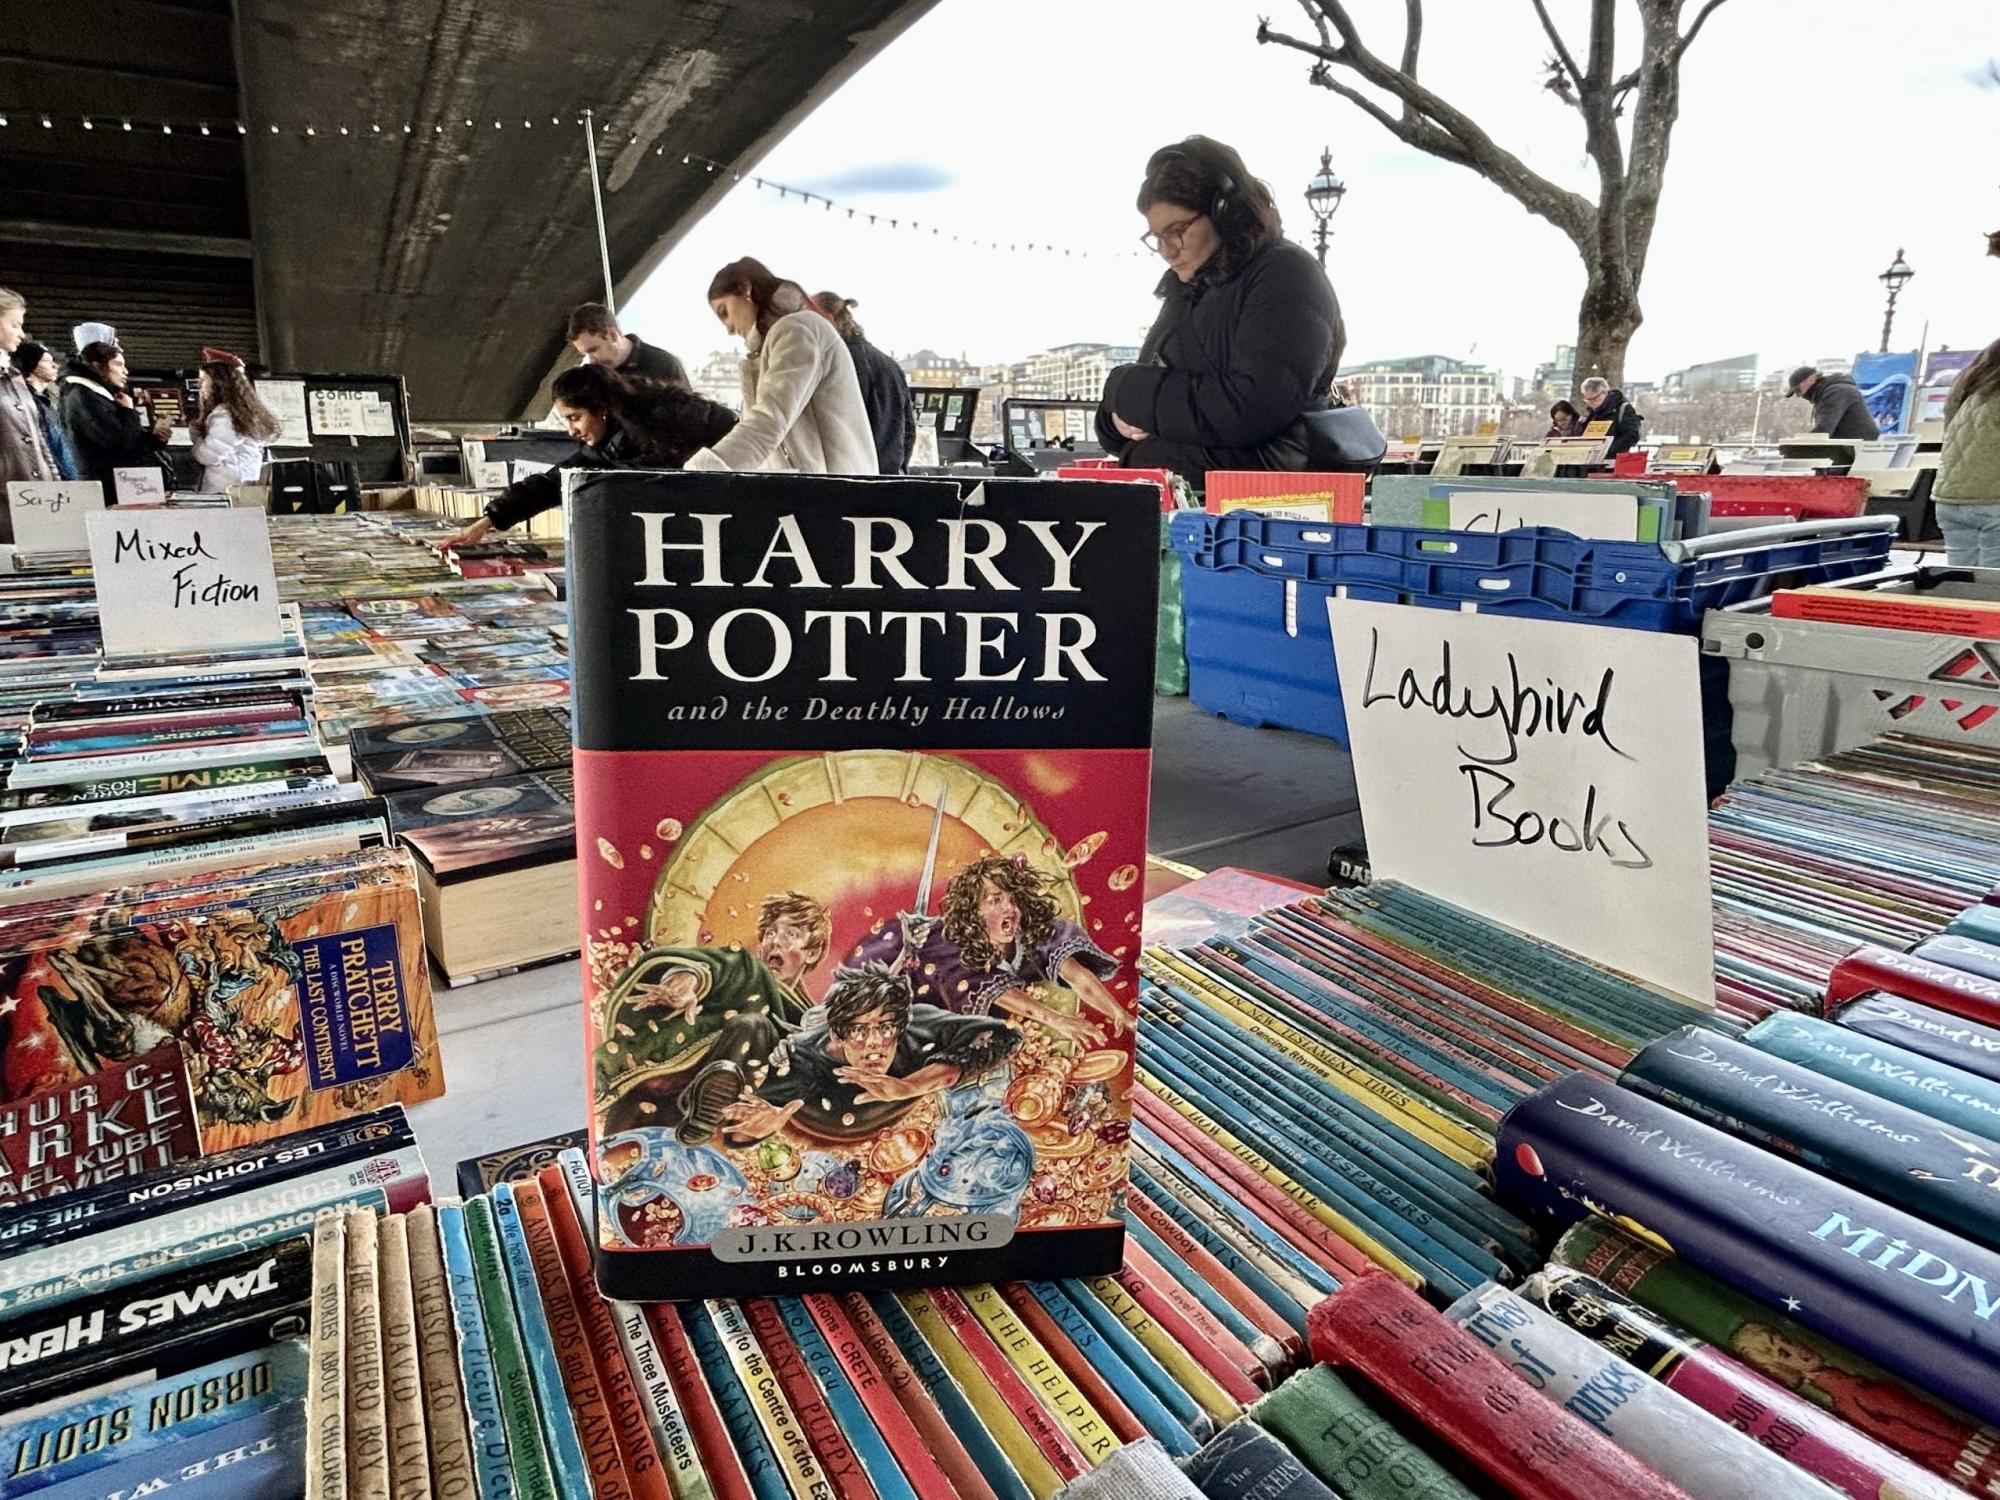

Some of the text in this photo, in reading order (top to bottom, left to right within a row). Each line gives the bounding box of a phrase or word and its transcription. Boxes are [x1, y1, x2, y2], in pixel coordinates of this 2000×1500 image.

[16, 489, 71, 513] Sci-fi
[115, 528, 217, 563] Mixed
[633, 512, 1107, 594] HARRY
[173, 563, 259, 608] Fiction
[627, 608, 1107, 684] POTTER
[668, 696, 1066, 727] and the Deathly Hallows
[1362, 628, 1637, 764] Ladybird
[85, 780, 137, 793] ROSE
[138, 770, 212, 793] ME
[216, 765, 326, 785] SCREAM
[1459, 765, 1654, 868] Books
[340, 936, 382, 1068] PRATCHETT
[370, 959, 403, 1033] TERRY
[1876, 951, 1954, 983] David
[302, 944, 337, 1081] THE LAST CONTINENT
[1200, 977, 1412, 1108] LIFE IN NEW TESTAMENT TIMES
[1308, 993, 1350, 1023] Things
[1356, 1022, 1376, 1037] we
[1791, 1025, 1873, 1067] David
[1861, 1006, 1971, 1043] David
[1249, 1024, 1330, 1079] Dancing Rhymes
[1666, 1045, 1920, 1145] David Walliams
[1155, 1086, 1324, 1212] AND HOW THEY LIVE
[1181, 1053, 1210, 1075] THE
[1213, 1074, 1269, 1112] STORY
[1270, 1113, 1294, 1131] OF
[1298, 1134, 1435, 1226] NEWSPAPERS
[1268, 1134, 1309, 1165] Games
[1556, 1096, 1792, 1206] David Walliams
[47, 1140, 326, 1228] LES JOHNSON THE
[569, 1159, 592, 1198] FICTION
[495, 1196, 531, 1290] 2a We have fun
[737, 1221, 990, 1256] J.K.ROWLING
[1130, 1192, 1199, 1254] the Cowboy
[118, 1258, 279, 1335] JAMES
[351, 1262, 374, 1295] THE
[453, 1273, 474, 1287] A
[778, 1256, 950, 1279] BLOOMSBURY
[320, 1282, 341, 1402] STORIES ABOUT
[418, 1274, 456, 1412] OF JOSEPH
[460, 1293, 480, 1339] First
[552, 1292, 583, 1350] BIRDS
[888, 1308, 949, 1386] JOSEPH
[351, 1304, 382, 1413] SHEPHERD
[387, 1323, 419, 1403] DAVID
[470, 1348, 497, 1431] Picture
[566, 1353, 586, 1383] and
[624, 1313, 693, 1471] The Three Musketeers
[839, 1341, 879, 1390] CRETE
[871, 1332, 899, 1374] (Book
[893, 1370, 914, 1389] 2)
[991, 1308, 1112, 1456] THE HELPER
[1511, 1338, 1557, 1390] of
[7, 1361, 273, 1479] ORSON SCOTT
[507, 1367, 537, 1462] Subtraction
[574, 1383, 622, 1476] PLANTS
[609, 1371, 656, 1474] READING
[702, 1340, 771, 1477] OF SAINTS
[735, 1335, 750, 1351] to
[744, 1352, 764, 1377] the
[757, 1377, 789, 1427] Centre
[782, 1430, 802, 1447] of
[794, 1447, 816, 1479] the
[800, 1401, 860, 1478] PUPPY
[1024, 1405, 1051, 1438] Level
[179, 1436, 278, 1480] THE
